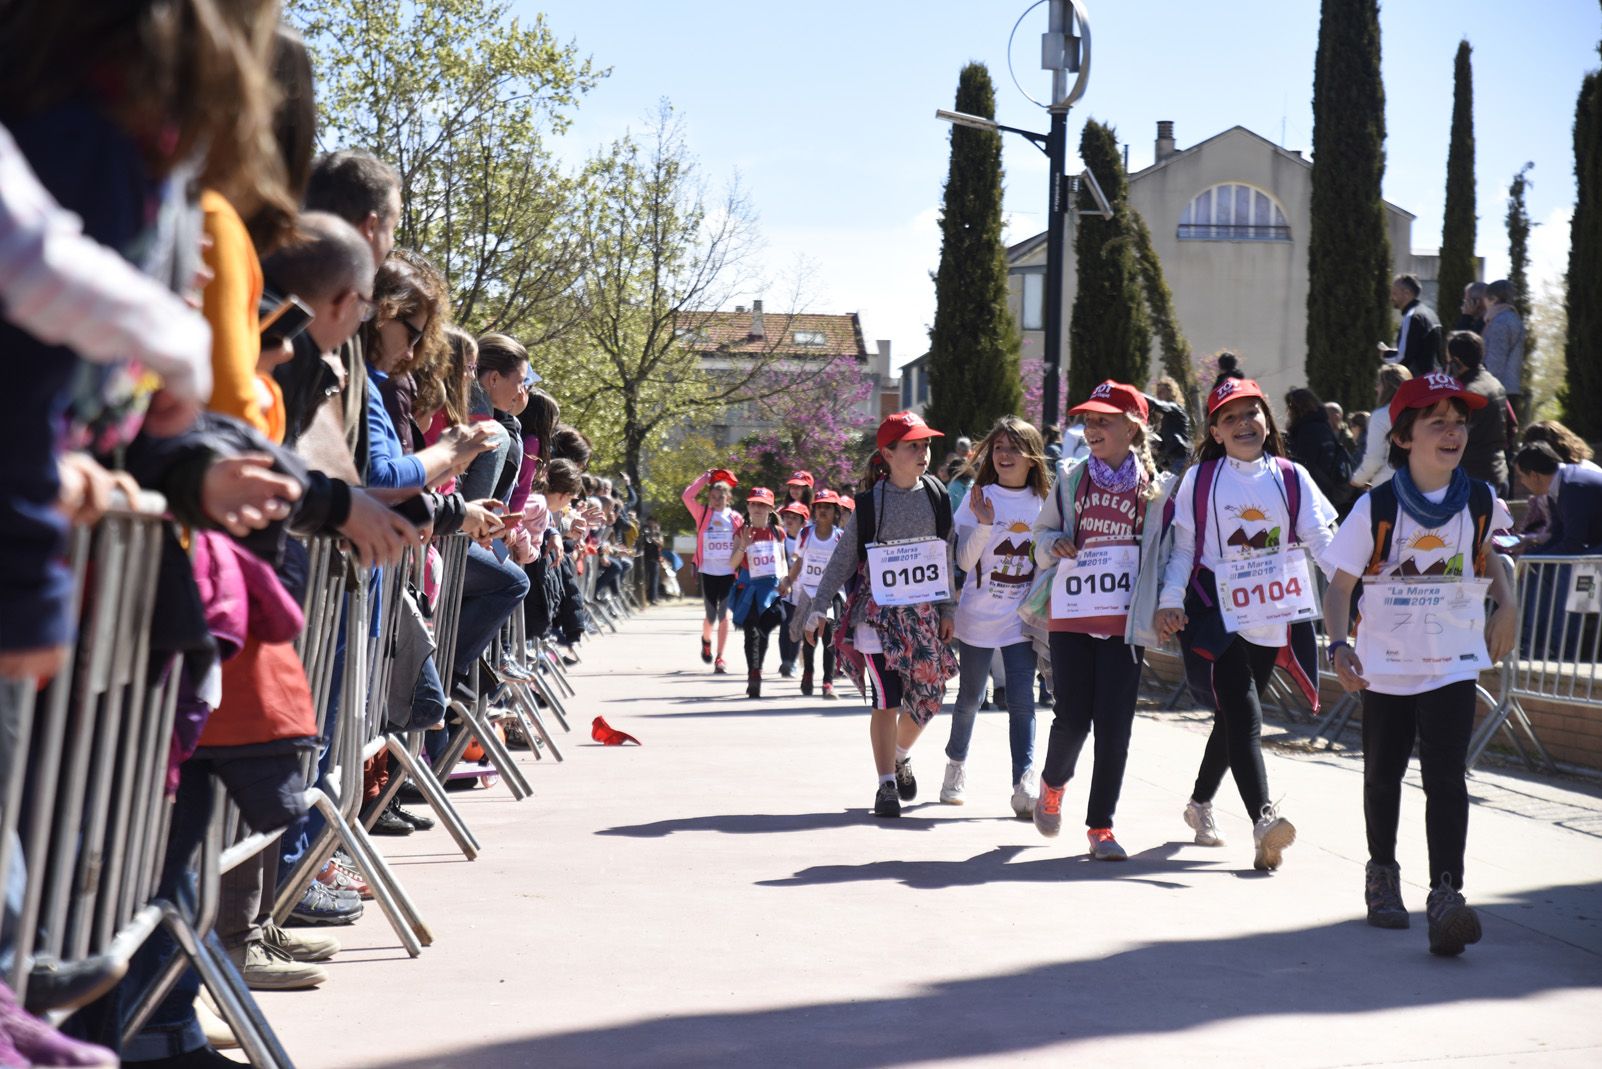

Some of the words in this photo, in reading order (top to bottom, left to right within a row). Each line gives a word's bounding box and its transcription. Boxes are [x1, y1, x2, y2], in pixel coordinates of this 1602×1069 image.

[882, 563, 939, 588] 0103
[1247, 560, 1273, 569] Marxa
[1066, 572, 1131, 596] 0104
[1231, 577, 1302, 608] 0104
[1407, 587, 1440, 595] Marxa
